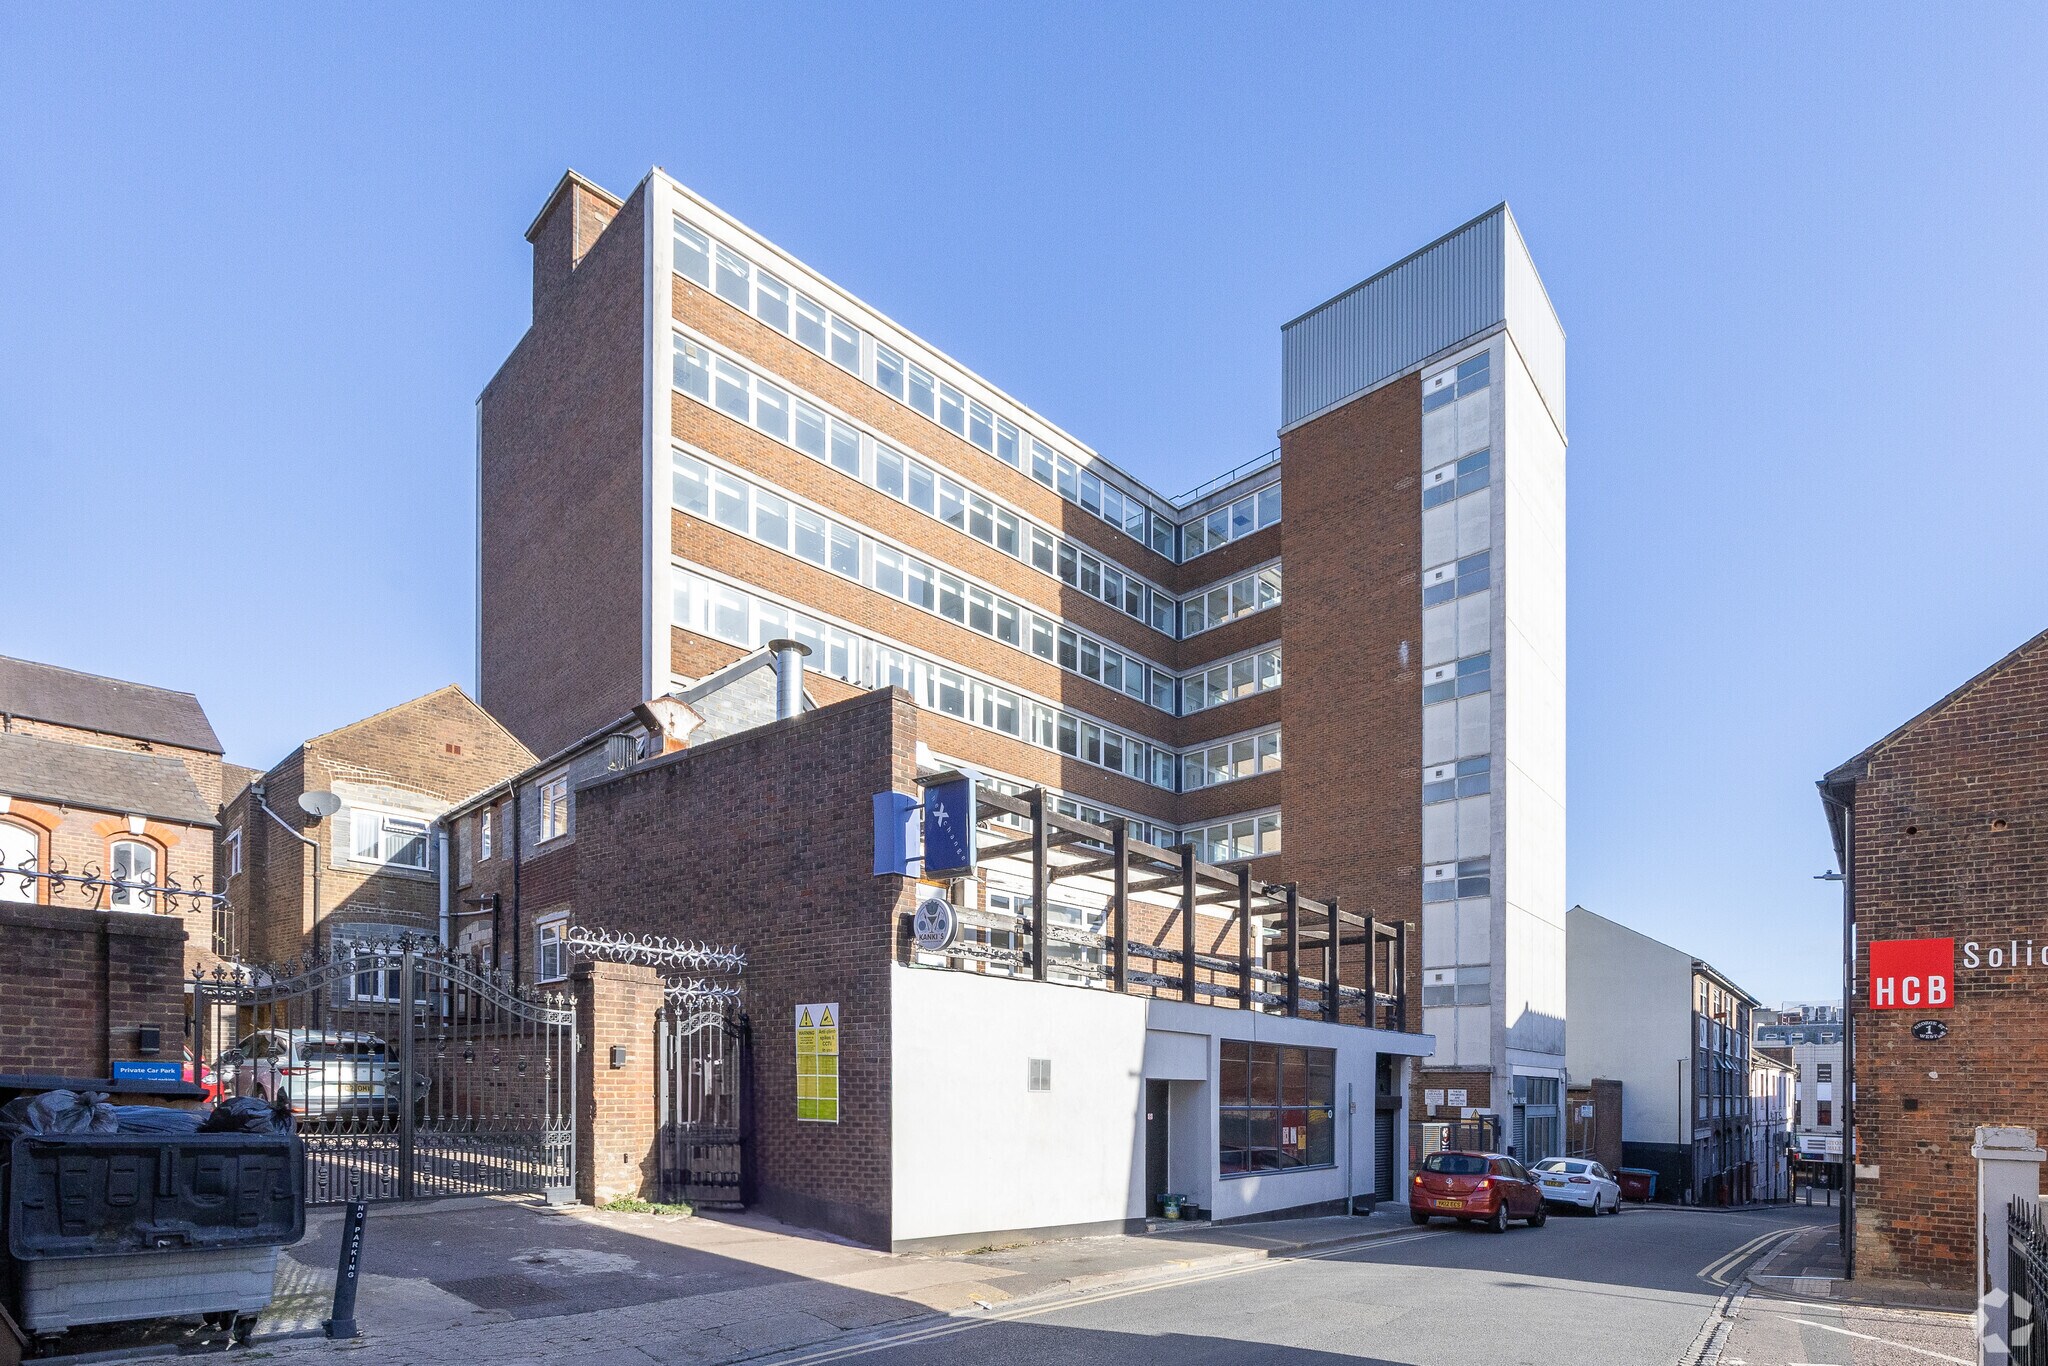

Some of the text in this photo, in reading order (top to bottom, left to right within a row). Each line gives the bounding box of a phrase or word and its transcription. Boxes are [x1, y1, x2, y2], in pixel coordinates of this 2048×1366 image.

[1876, 975, 1946, 1006] HCB
[1925, 1025, 1933, 1035] 1
[356, 1204, 364, 1219] NO
[347, 1226, 361, 1278] PARKING
